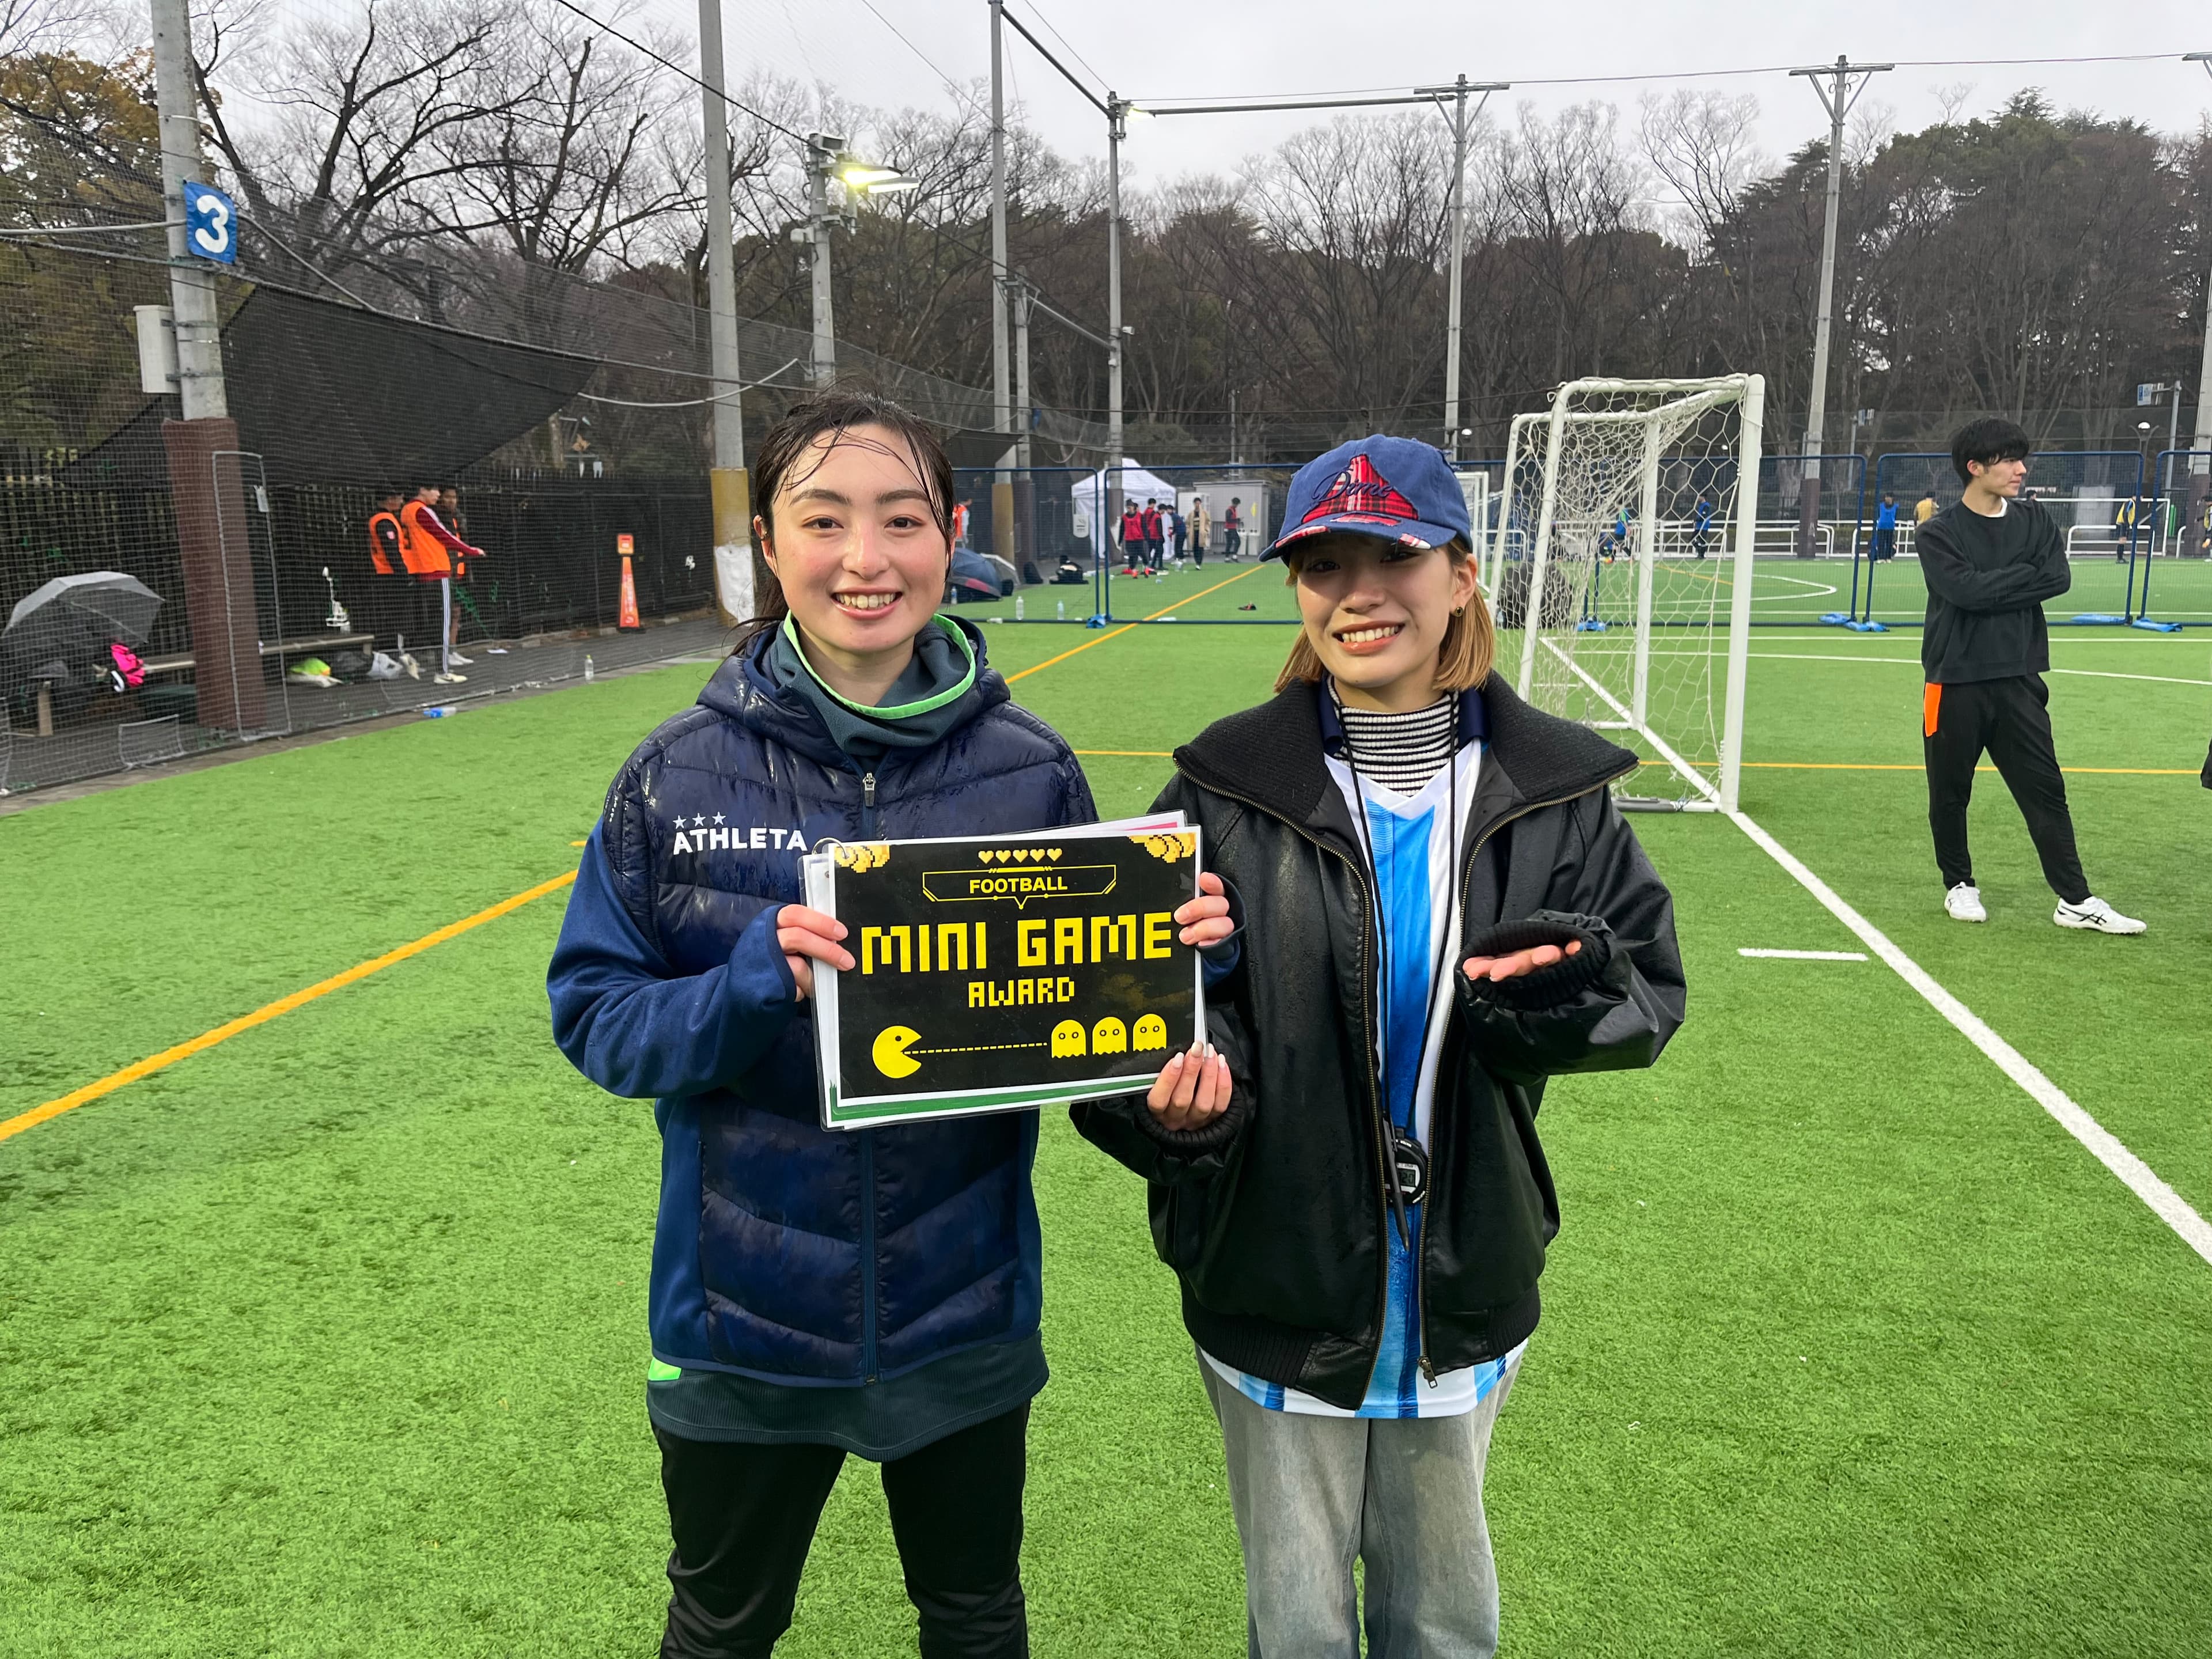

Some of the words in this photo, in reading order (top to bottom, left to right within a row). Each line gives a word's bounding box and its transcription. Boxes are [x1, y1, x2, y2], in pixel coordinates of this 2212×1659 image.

[195, 194, 229, 253] 3
[1312, 467, 1395, 502] Dime
[673, 827, 808, 855] ATHLETA
[969, 876, 1068, 895] FOOTBALL
[861, 922, 987, 975] MINI
[1017, 911, 1172, 967] GAME
[968, 976, 1075, 1008] AWARD
